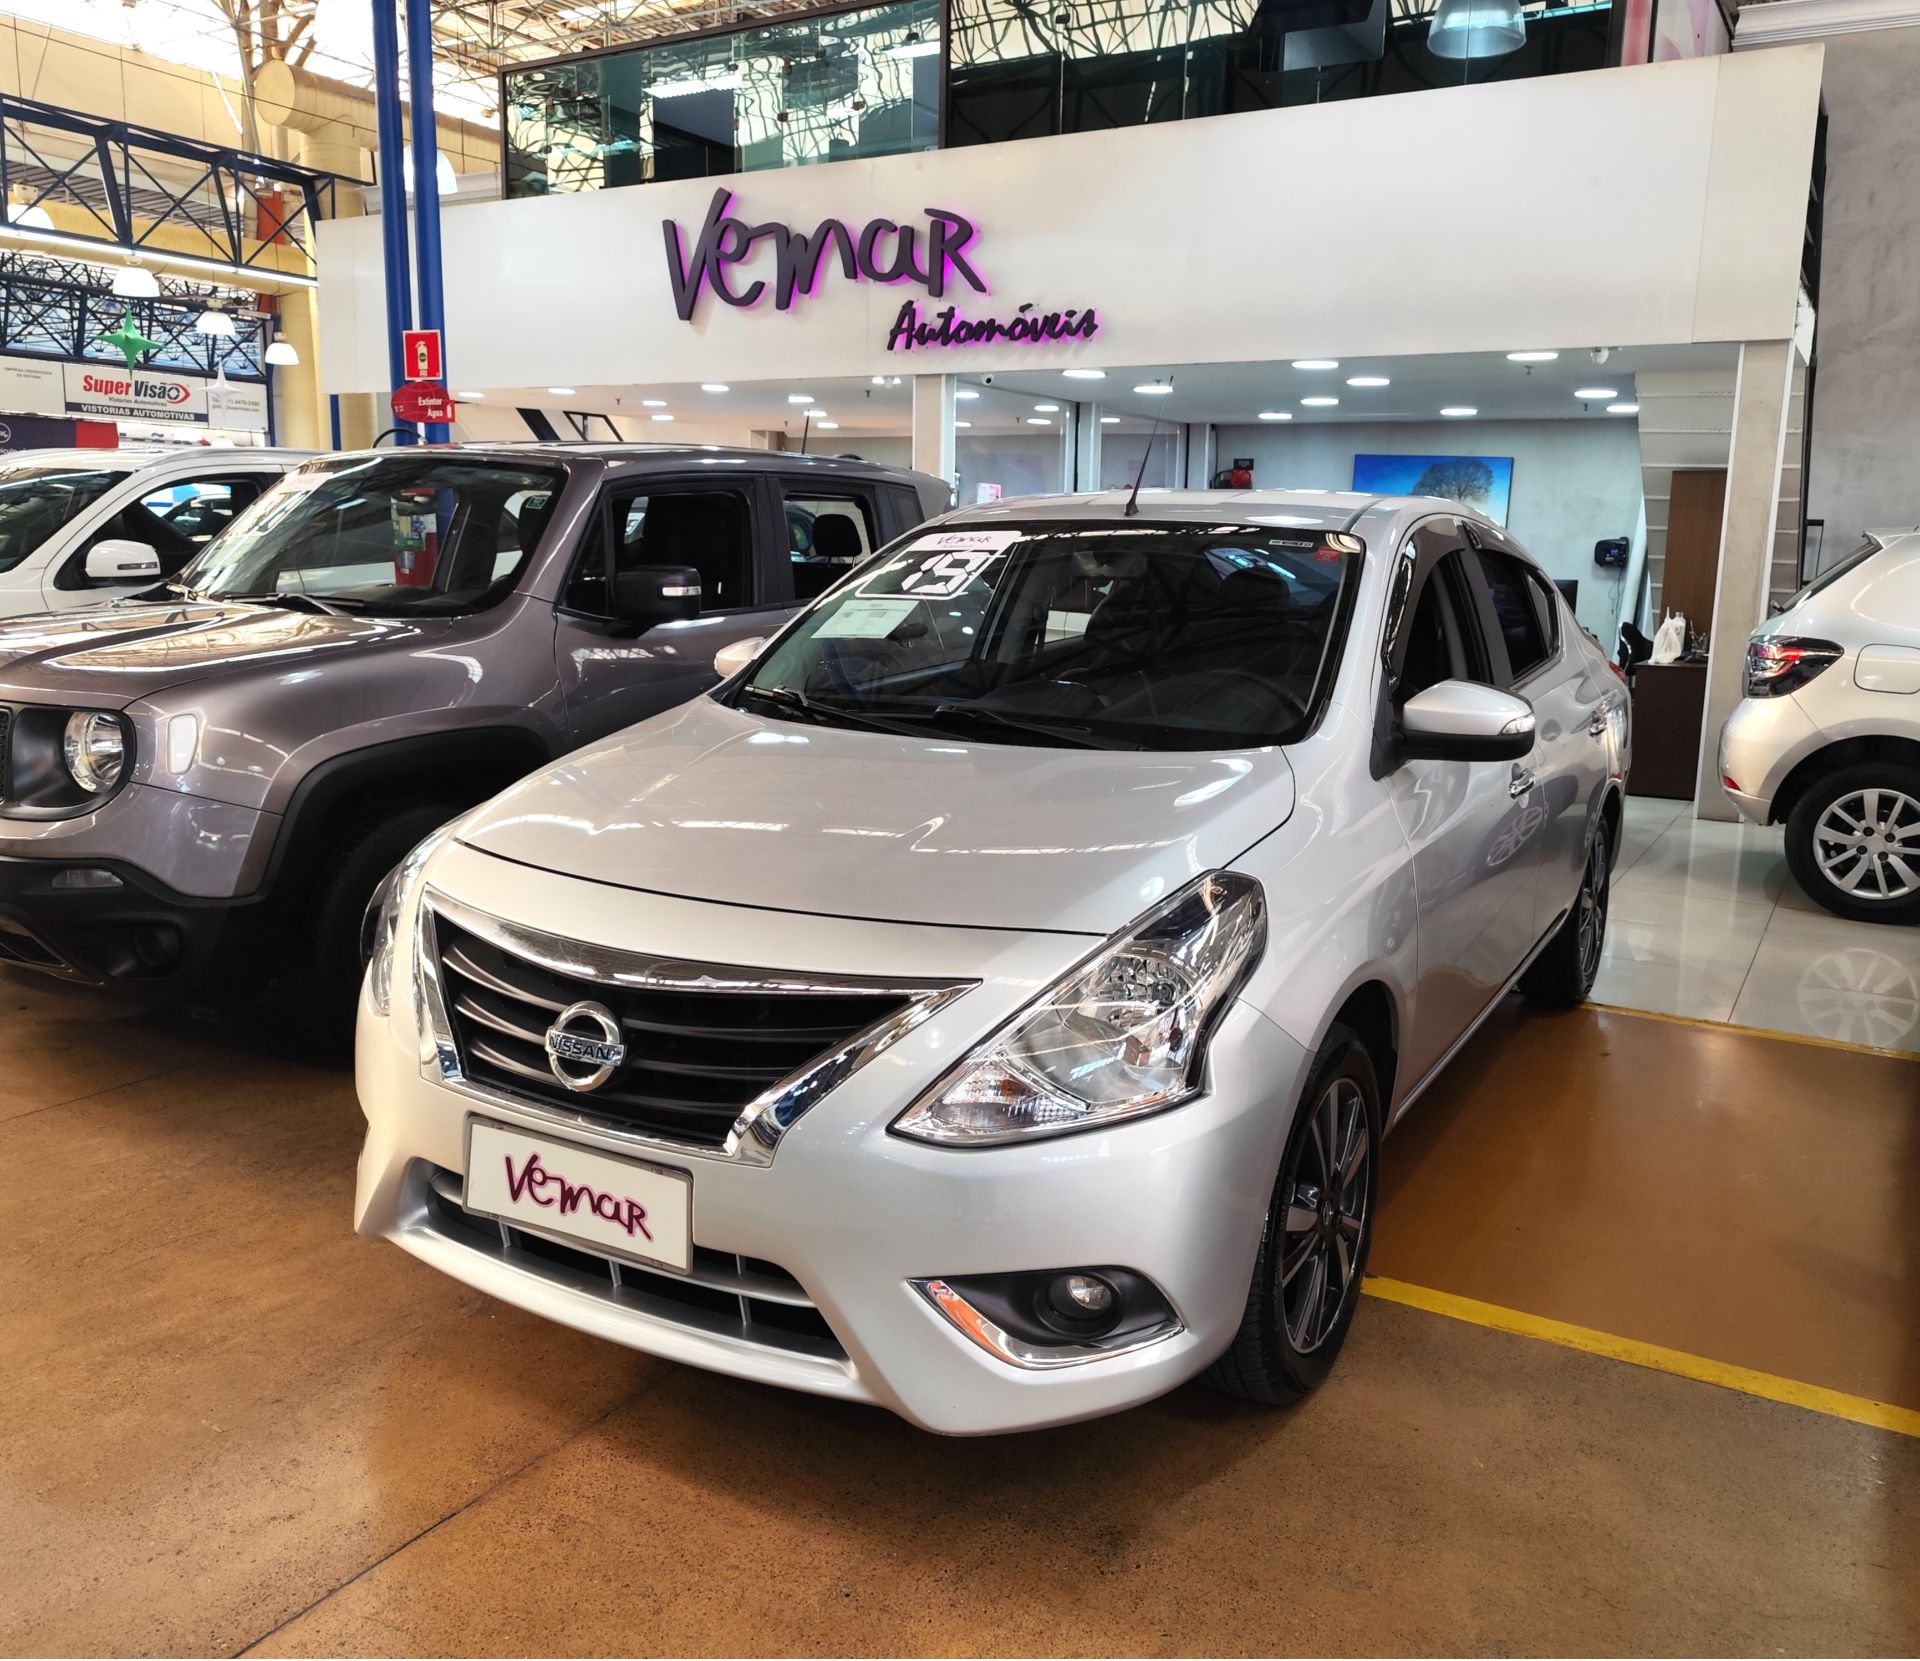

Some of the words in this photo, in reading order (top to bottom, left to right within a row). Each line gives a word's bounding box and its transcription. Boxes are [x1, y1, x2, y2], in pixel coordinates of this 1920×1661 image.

[887, 299, 1098, 351] Automóveis
[83, 375, 132, 396] Super
[134, 380, 180, 400] Visão
[81, 404, 131, 416] VISTORIAS
[132, 408, 195, 421] AUTOMOTIVAS
[549, 1034, 610, 1060] NISSAN
